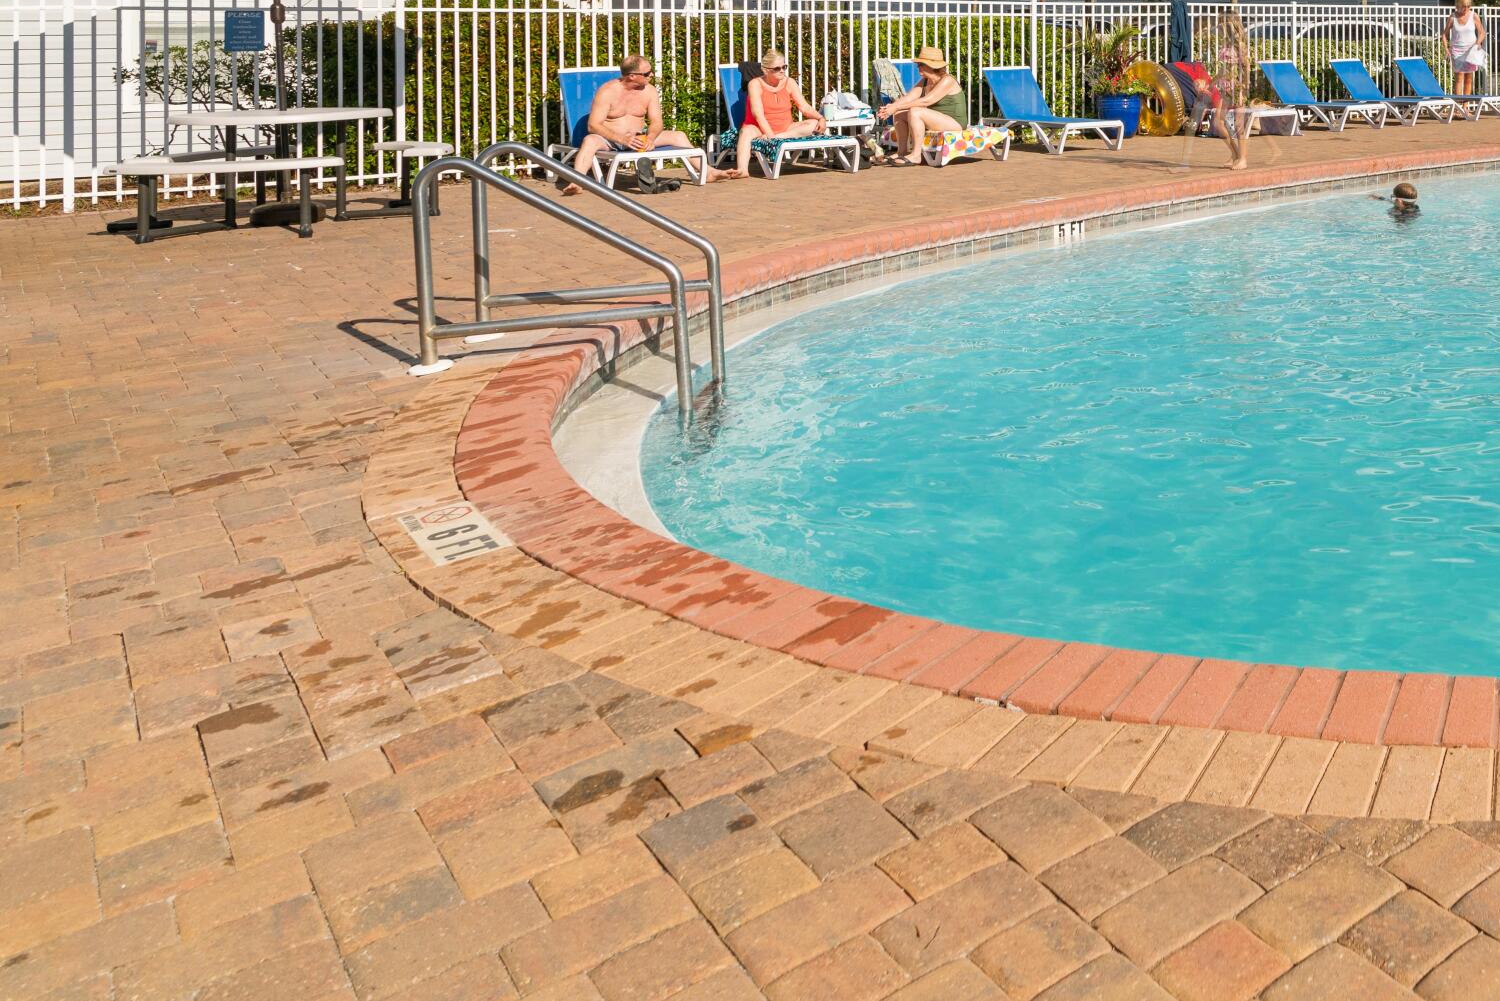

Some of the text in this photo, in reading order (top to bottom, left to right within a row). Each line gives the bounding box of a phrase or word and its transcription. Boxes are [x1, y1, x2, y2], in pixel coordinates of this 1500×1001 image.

[1058, 220, 1083, 237] 5 FT
[427, 523, 479, 541] 6
